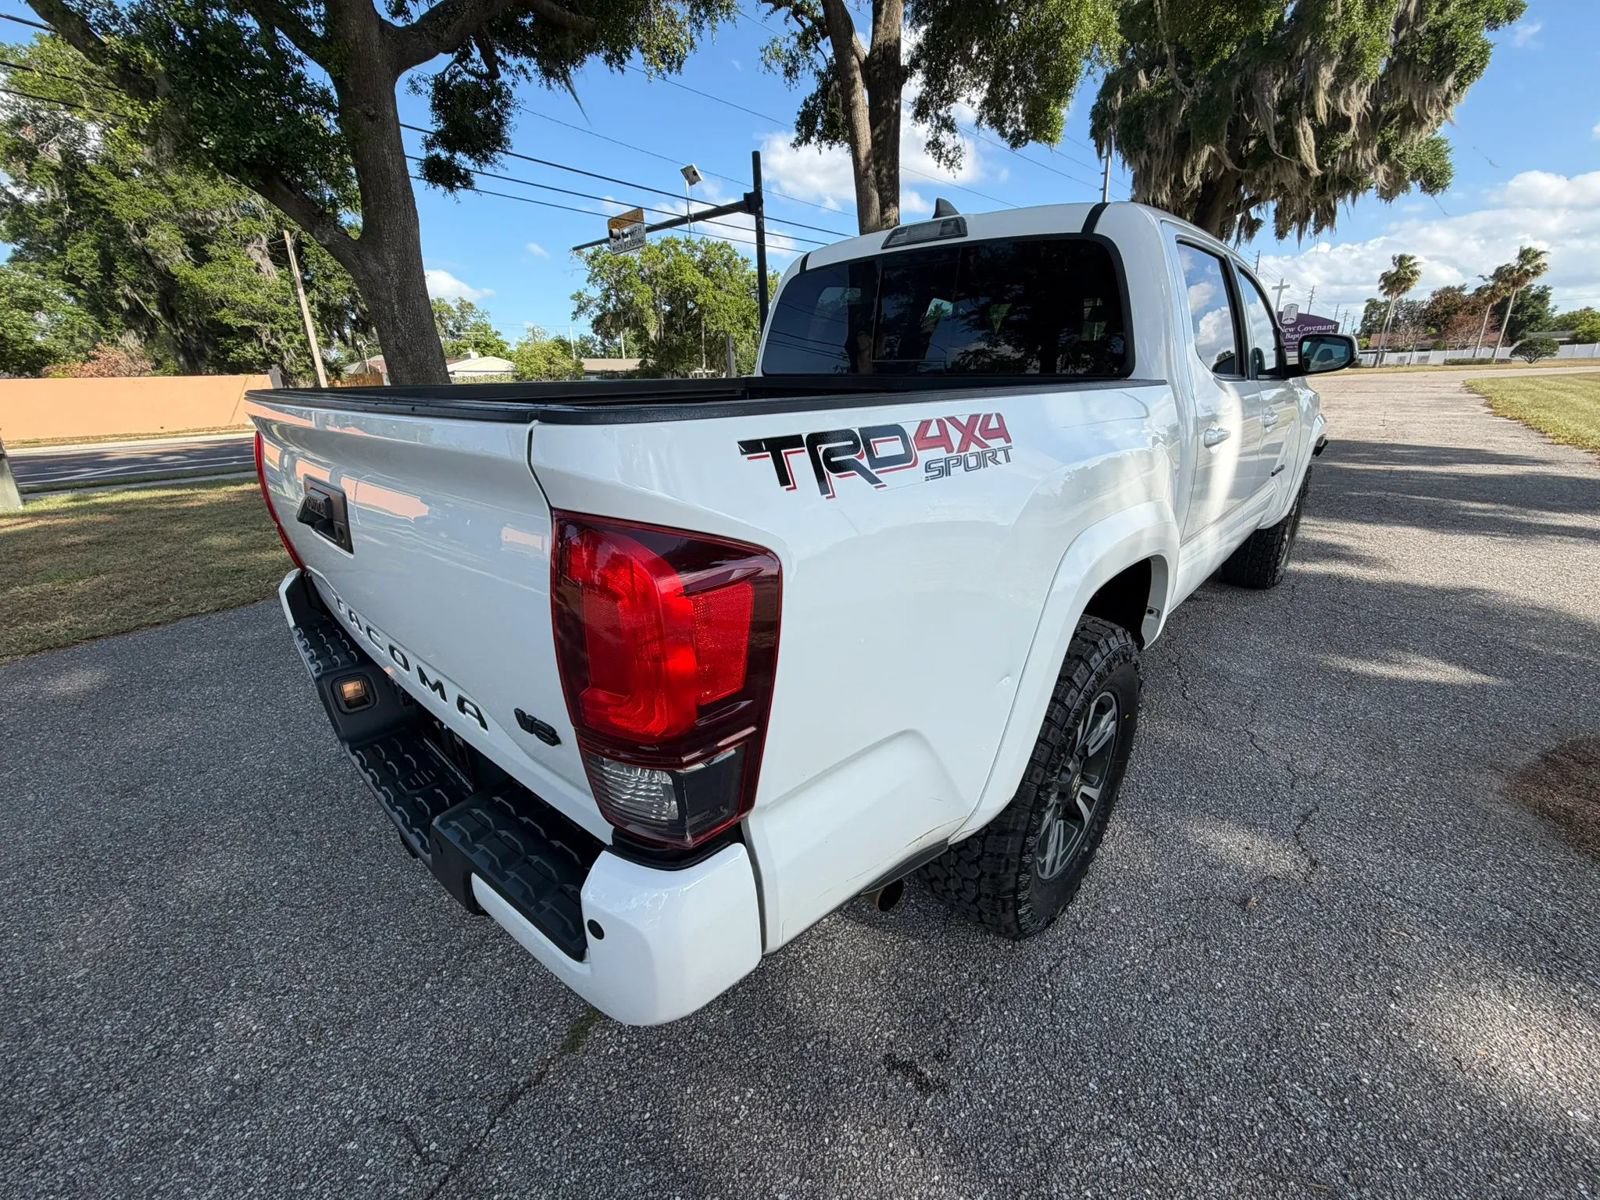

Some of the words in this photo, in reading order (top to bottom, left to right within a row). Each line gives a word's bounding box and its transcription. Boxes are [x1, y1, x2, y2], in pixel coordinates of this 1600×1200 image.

[1297, 323, 1336, 332] Covenant
[737, 424, 919, 499] TRD
[924, 445, 1013, 482] SPORT
[332, 592, 489, 732] TACOMA
[513, 708, 562, 747] V6
